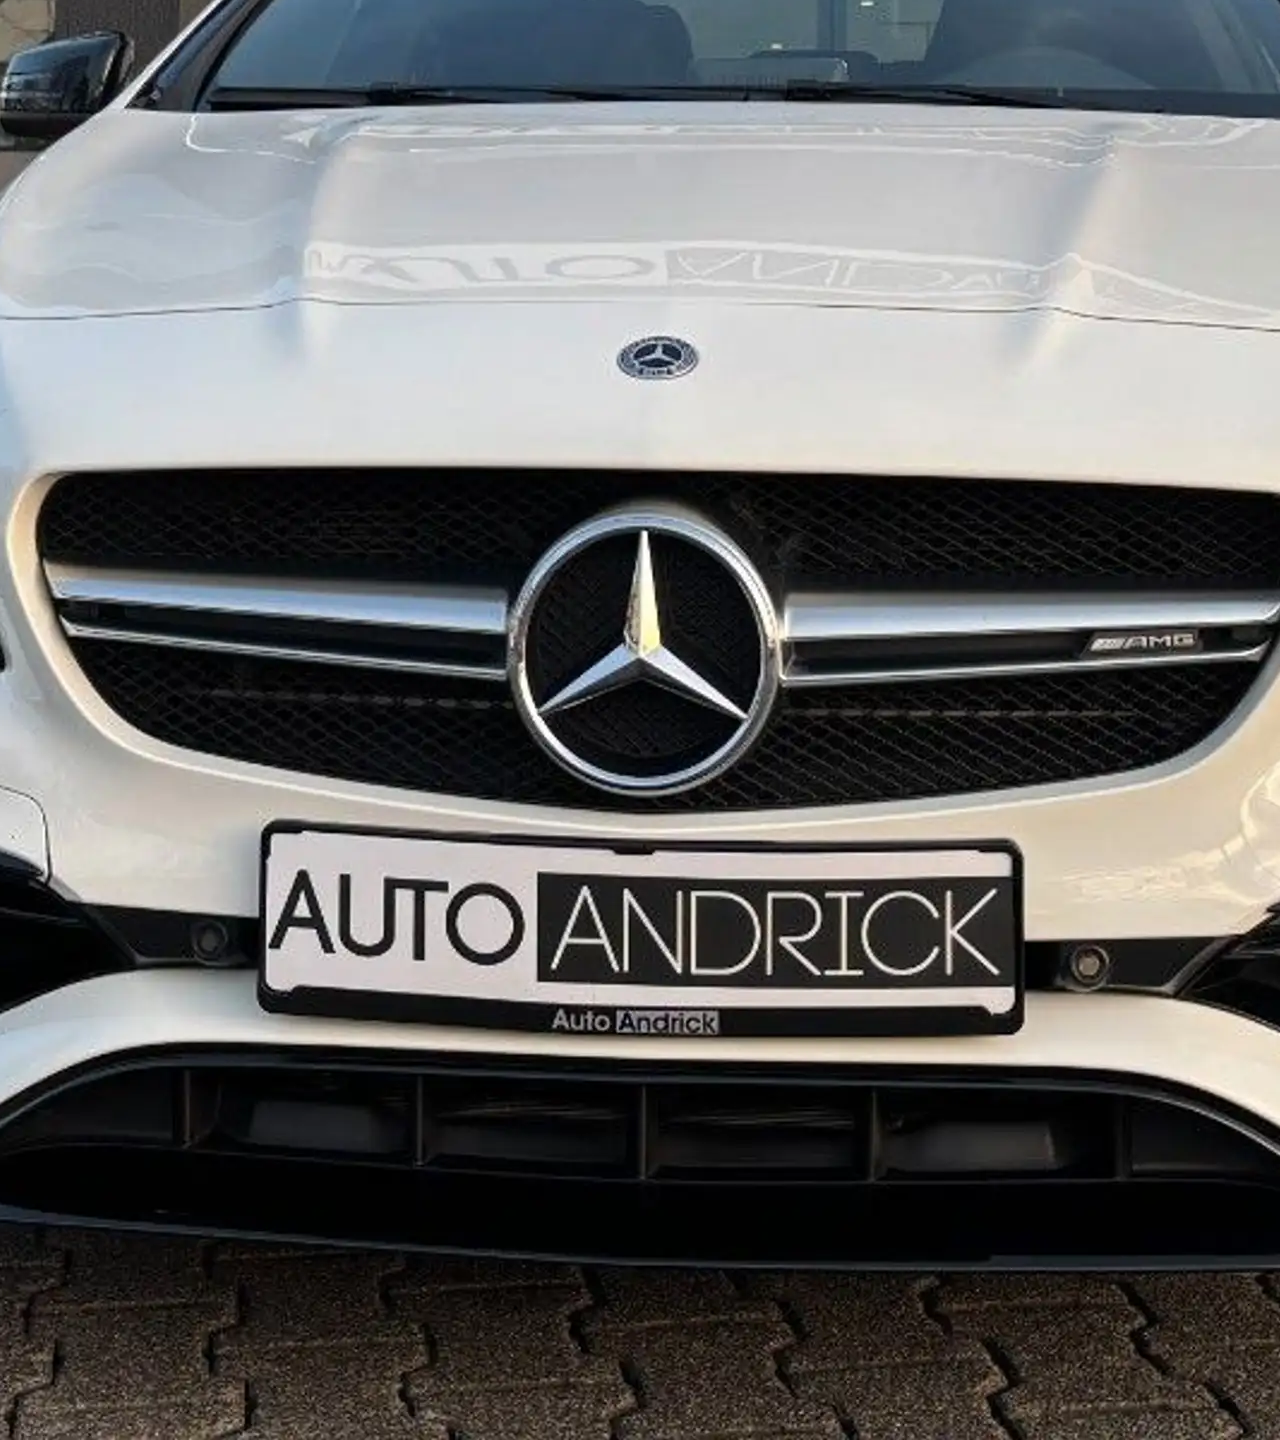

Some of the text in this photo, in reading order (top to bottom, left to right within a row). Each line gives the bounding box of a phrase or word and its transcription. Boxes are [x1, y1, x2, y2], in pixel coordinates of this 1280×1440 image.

[1123, 634, 1194, 650] AMG
[268, 869, 1001, 978] AUTO ANDRICK
[552, 1009, 716, 1035] Auto Andrick
